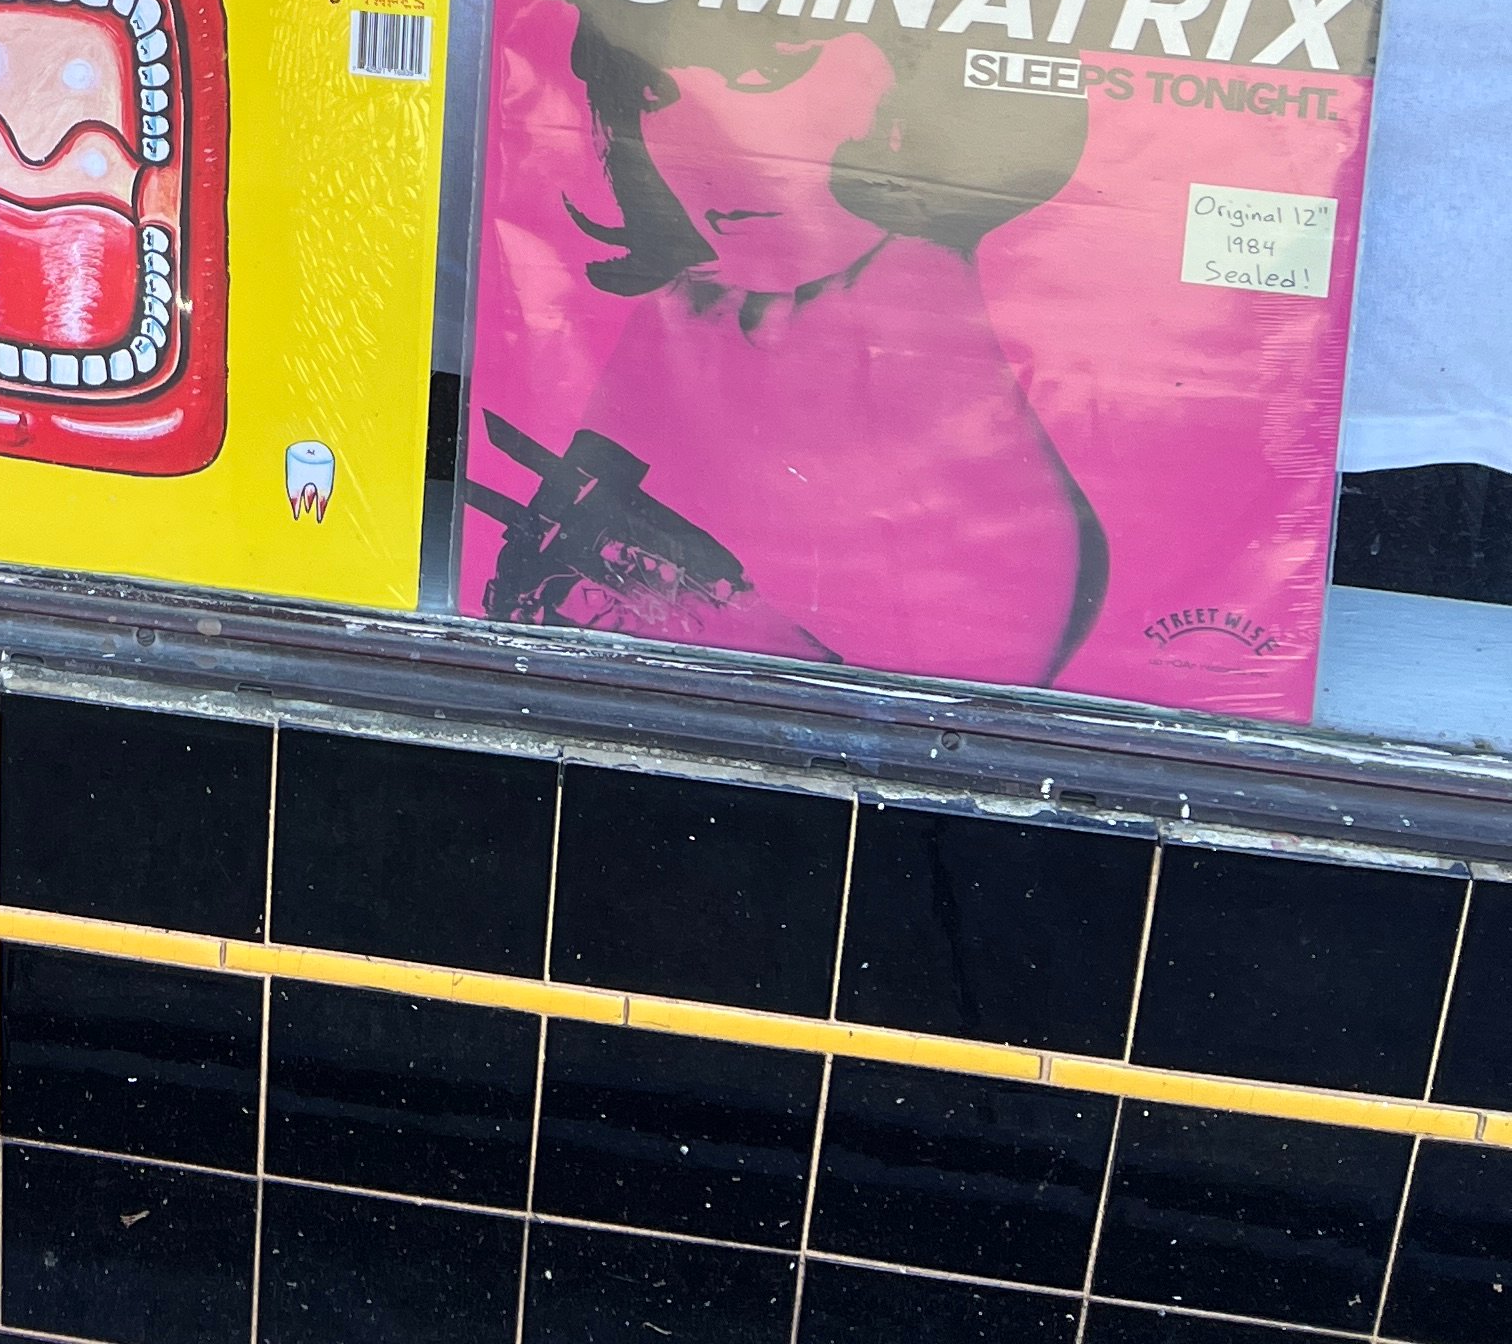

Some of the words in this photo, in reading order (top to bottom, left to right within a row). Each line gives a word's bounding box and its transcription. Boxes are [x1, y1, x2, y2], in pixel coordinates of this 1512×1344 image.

[966, 52, 1134, 102] SLEEPS
[1146, 71, 1340, 122] TONIGHT.
[1194, 195, 1282, 227] Original
[1294, 206, 1328, 227] 12"
[1227, 235, 1275, 256] 1984
[1143, 608, 1219, 647] STREET
[1224, 613, 1280, 657] WISE
